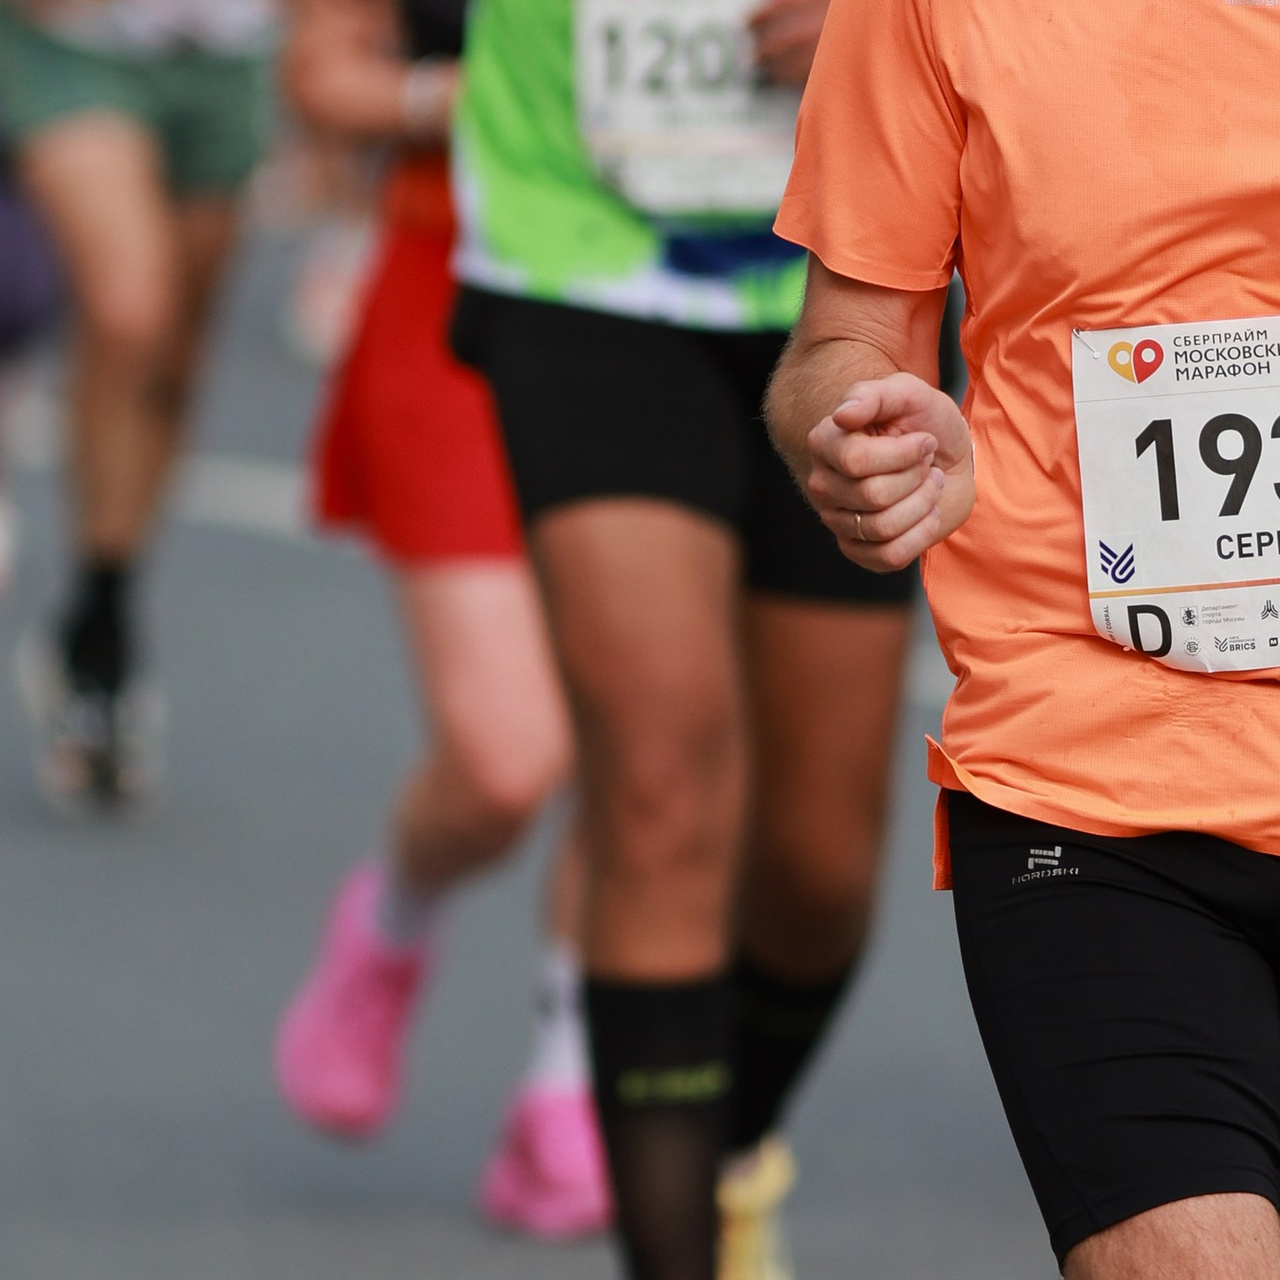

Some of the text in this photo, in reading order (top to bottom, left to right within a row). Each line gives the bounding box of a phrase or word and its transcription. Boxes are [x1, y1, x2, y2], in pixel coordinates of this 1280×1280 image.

[602, 19, 760, 95] 120
[1173, 329, 1268, 348] СБЕРПРАЙМ
[1176, 360, 1271, 382] МАРАФОН
[1127, 604, 1173, 658] D
[1229, 642, 1256, 652] BRICS
